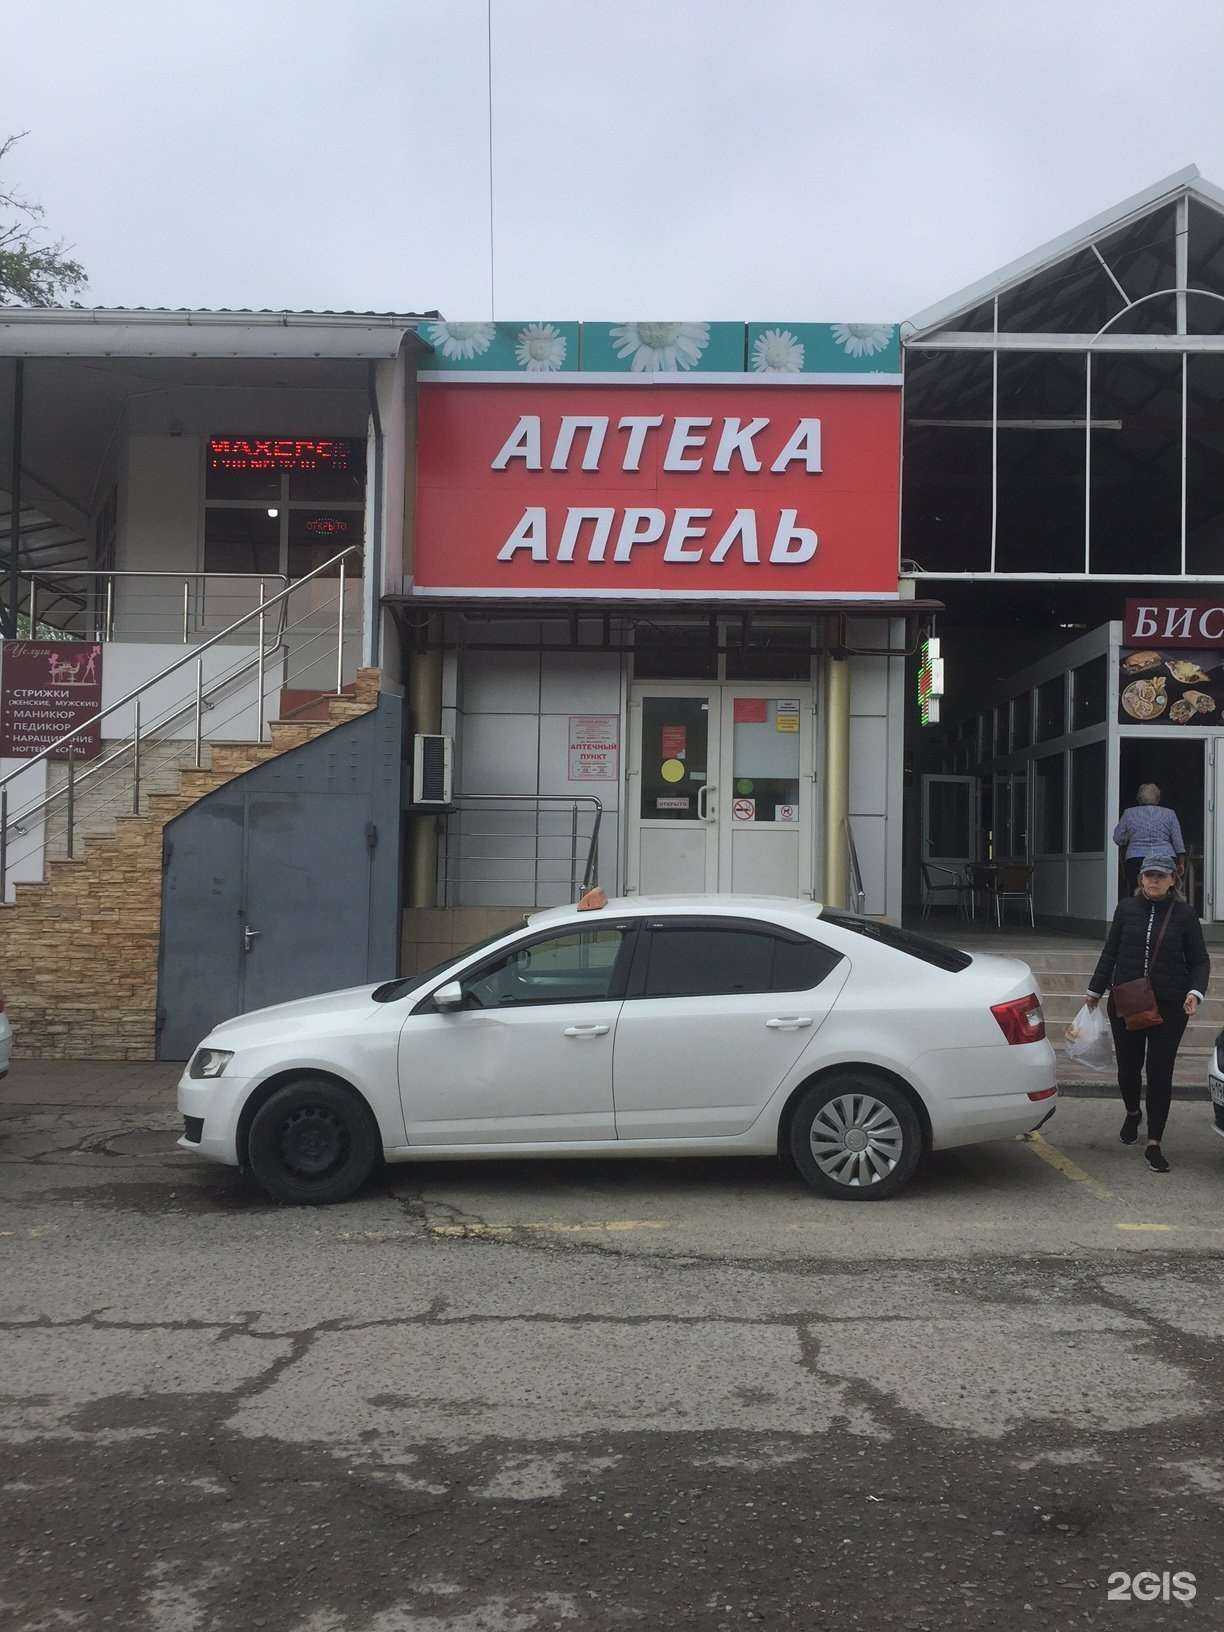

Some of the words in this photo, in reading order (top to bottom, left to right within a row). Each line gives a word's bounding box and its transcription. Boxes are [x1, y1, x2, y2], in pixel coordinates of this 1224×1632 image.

[490, 414, 823, 472] АПТЕКА
[496, 506, 818, 563] АПРЕЛЬ
[1131, 607, 1224, 639] БИС
[13, 689, 70, 698] СТРИЖКИ
[13, 710, 75, 719] МАНИКЮР
[13, 722, 71, 732] ПЕДИКЮР
[12, 734, 94, 744] НАРАЩИНИЕ
